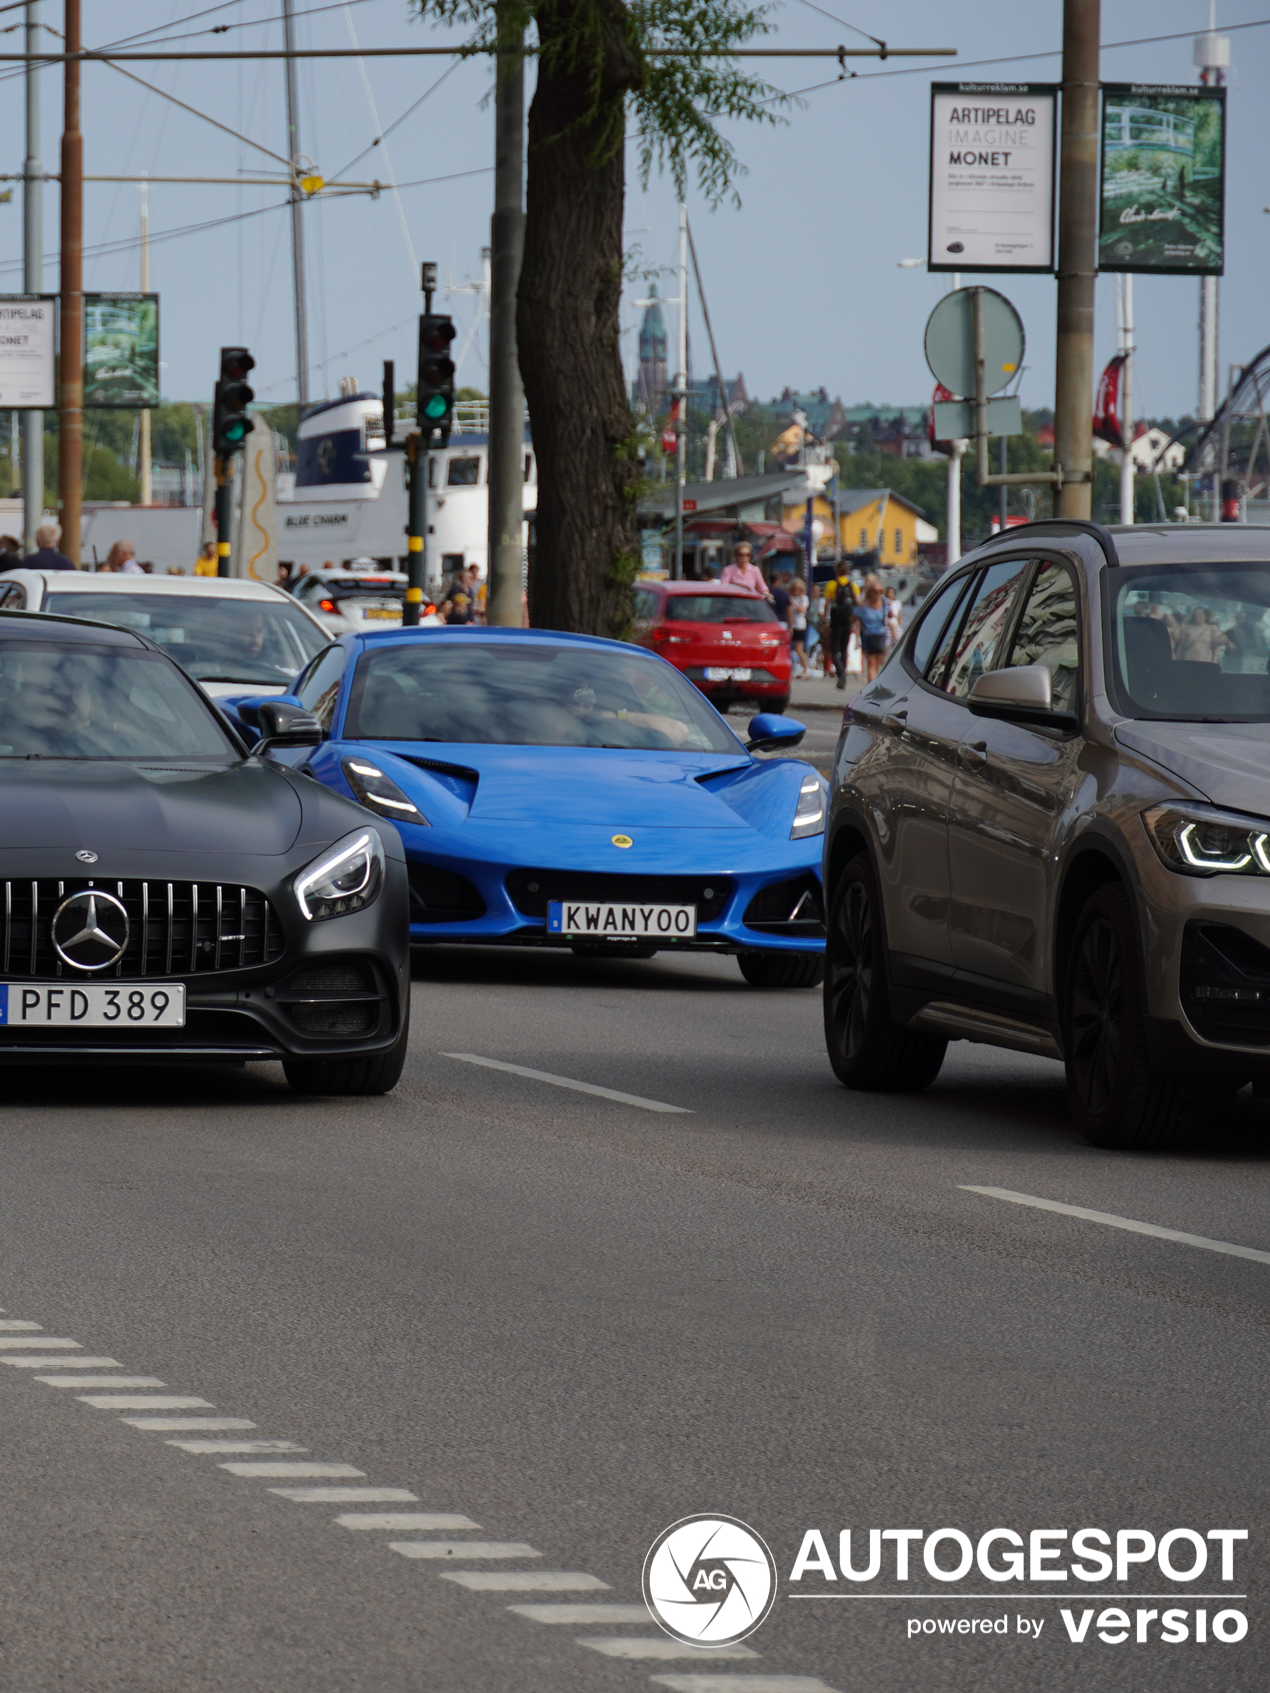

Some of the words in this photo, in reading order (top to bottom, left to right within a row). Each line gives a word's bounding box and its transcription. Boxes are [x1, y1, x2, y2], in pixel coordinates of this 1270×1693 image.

[959, 83, 1029, 92] kulturreklam.se
[1132, 85, 1199, 95] kulturreklam.se
[949, 107, 1035, 124] ARTIPELAG
[949, 129, 1029, 145] IMAGINE
[949, 151, 1012, 166] MONET
[285, 515, 309, 526] BLUE
[566, 906, 690, 932] KWANYOO
[22, 989, 89, 1020] PFD
[103, 990, 170, 1021] 389
